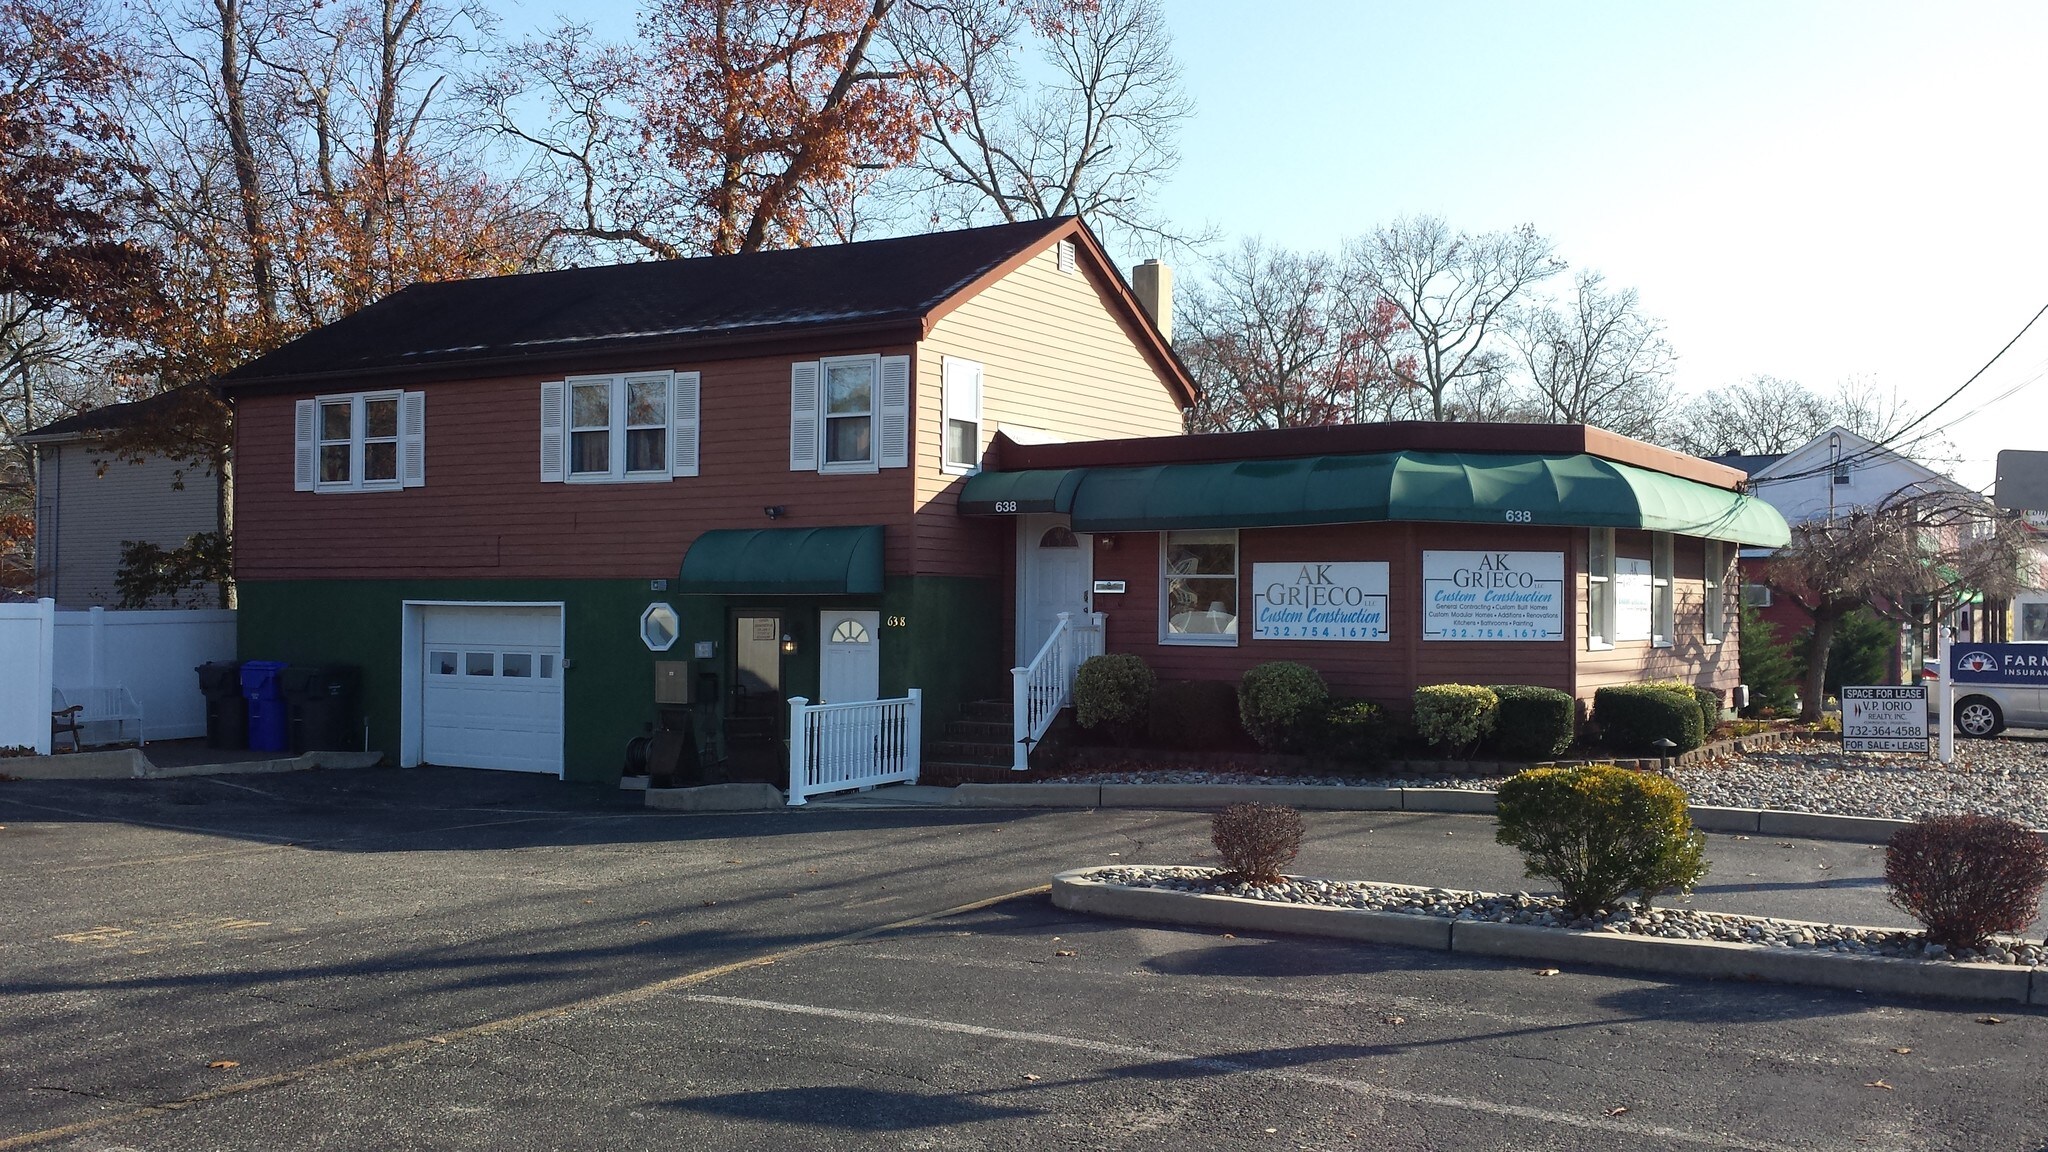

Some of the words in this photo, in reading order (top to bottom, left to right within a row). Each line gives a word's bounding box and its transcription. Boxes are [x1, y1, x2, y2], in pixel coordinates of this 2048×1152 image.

[995, 501, 1017, 513] 638
[1505, 510, 1532, 523] 638
[1478, 553, 1511, 571] AK
[1295, 564, 1335, 585] AK
[1453, 568, 1534, 590] GRIECO
[1265, 582, 1363, 609] GRIECO
[1434, 589, 1476, 602] Custom
[1484, 589, 1553, 603] Construction
[1459, 603, 1491, 611] Contracting
[887, 615, 906, 627] 638
[1261, 606, 1303, 623] Custom
[1307, 607, 1381, 624] Construction
[1264, 626, 1378, 638] 732.754.1673
[1442, 628, 1547, 638] 732.754.1673
[1847, 689, 1874, 698] SPACE
[1876, 689, 1893, 698] FOR
[1895, 689, 1922, 698] LEASE
[1882, 701, 1913, 711] IORIO
[1849, 726, 1922, 736] 732-364-4588
[1845, 740, 1863, 749] FOR
[1867, 741, 1890, 749] SALE
[1897, 741, 1926, 750] LEASE
